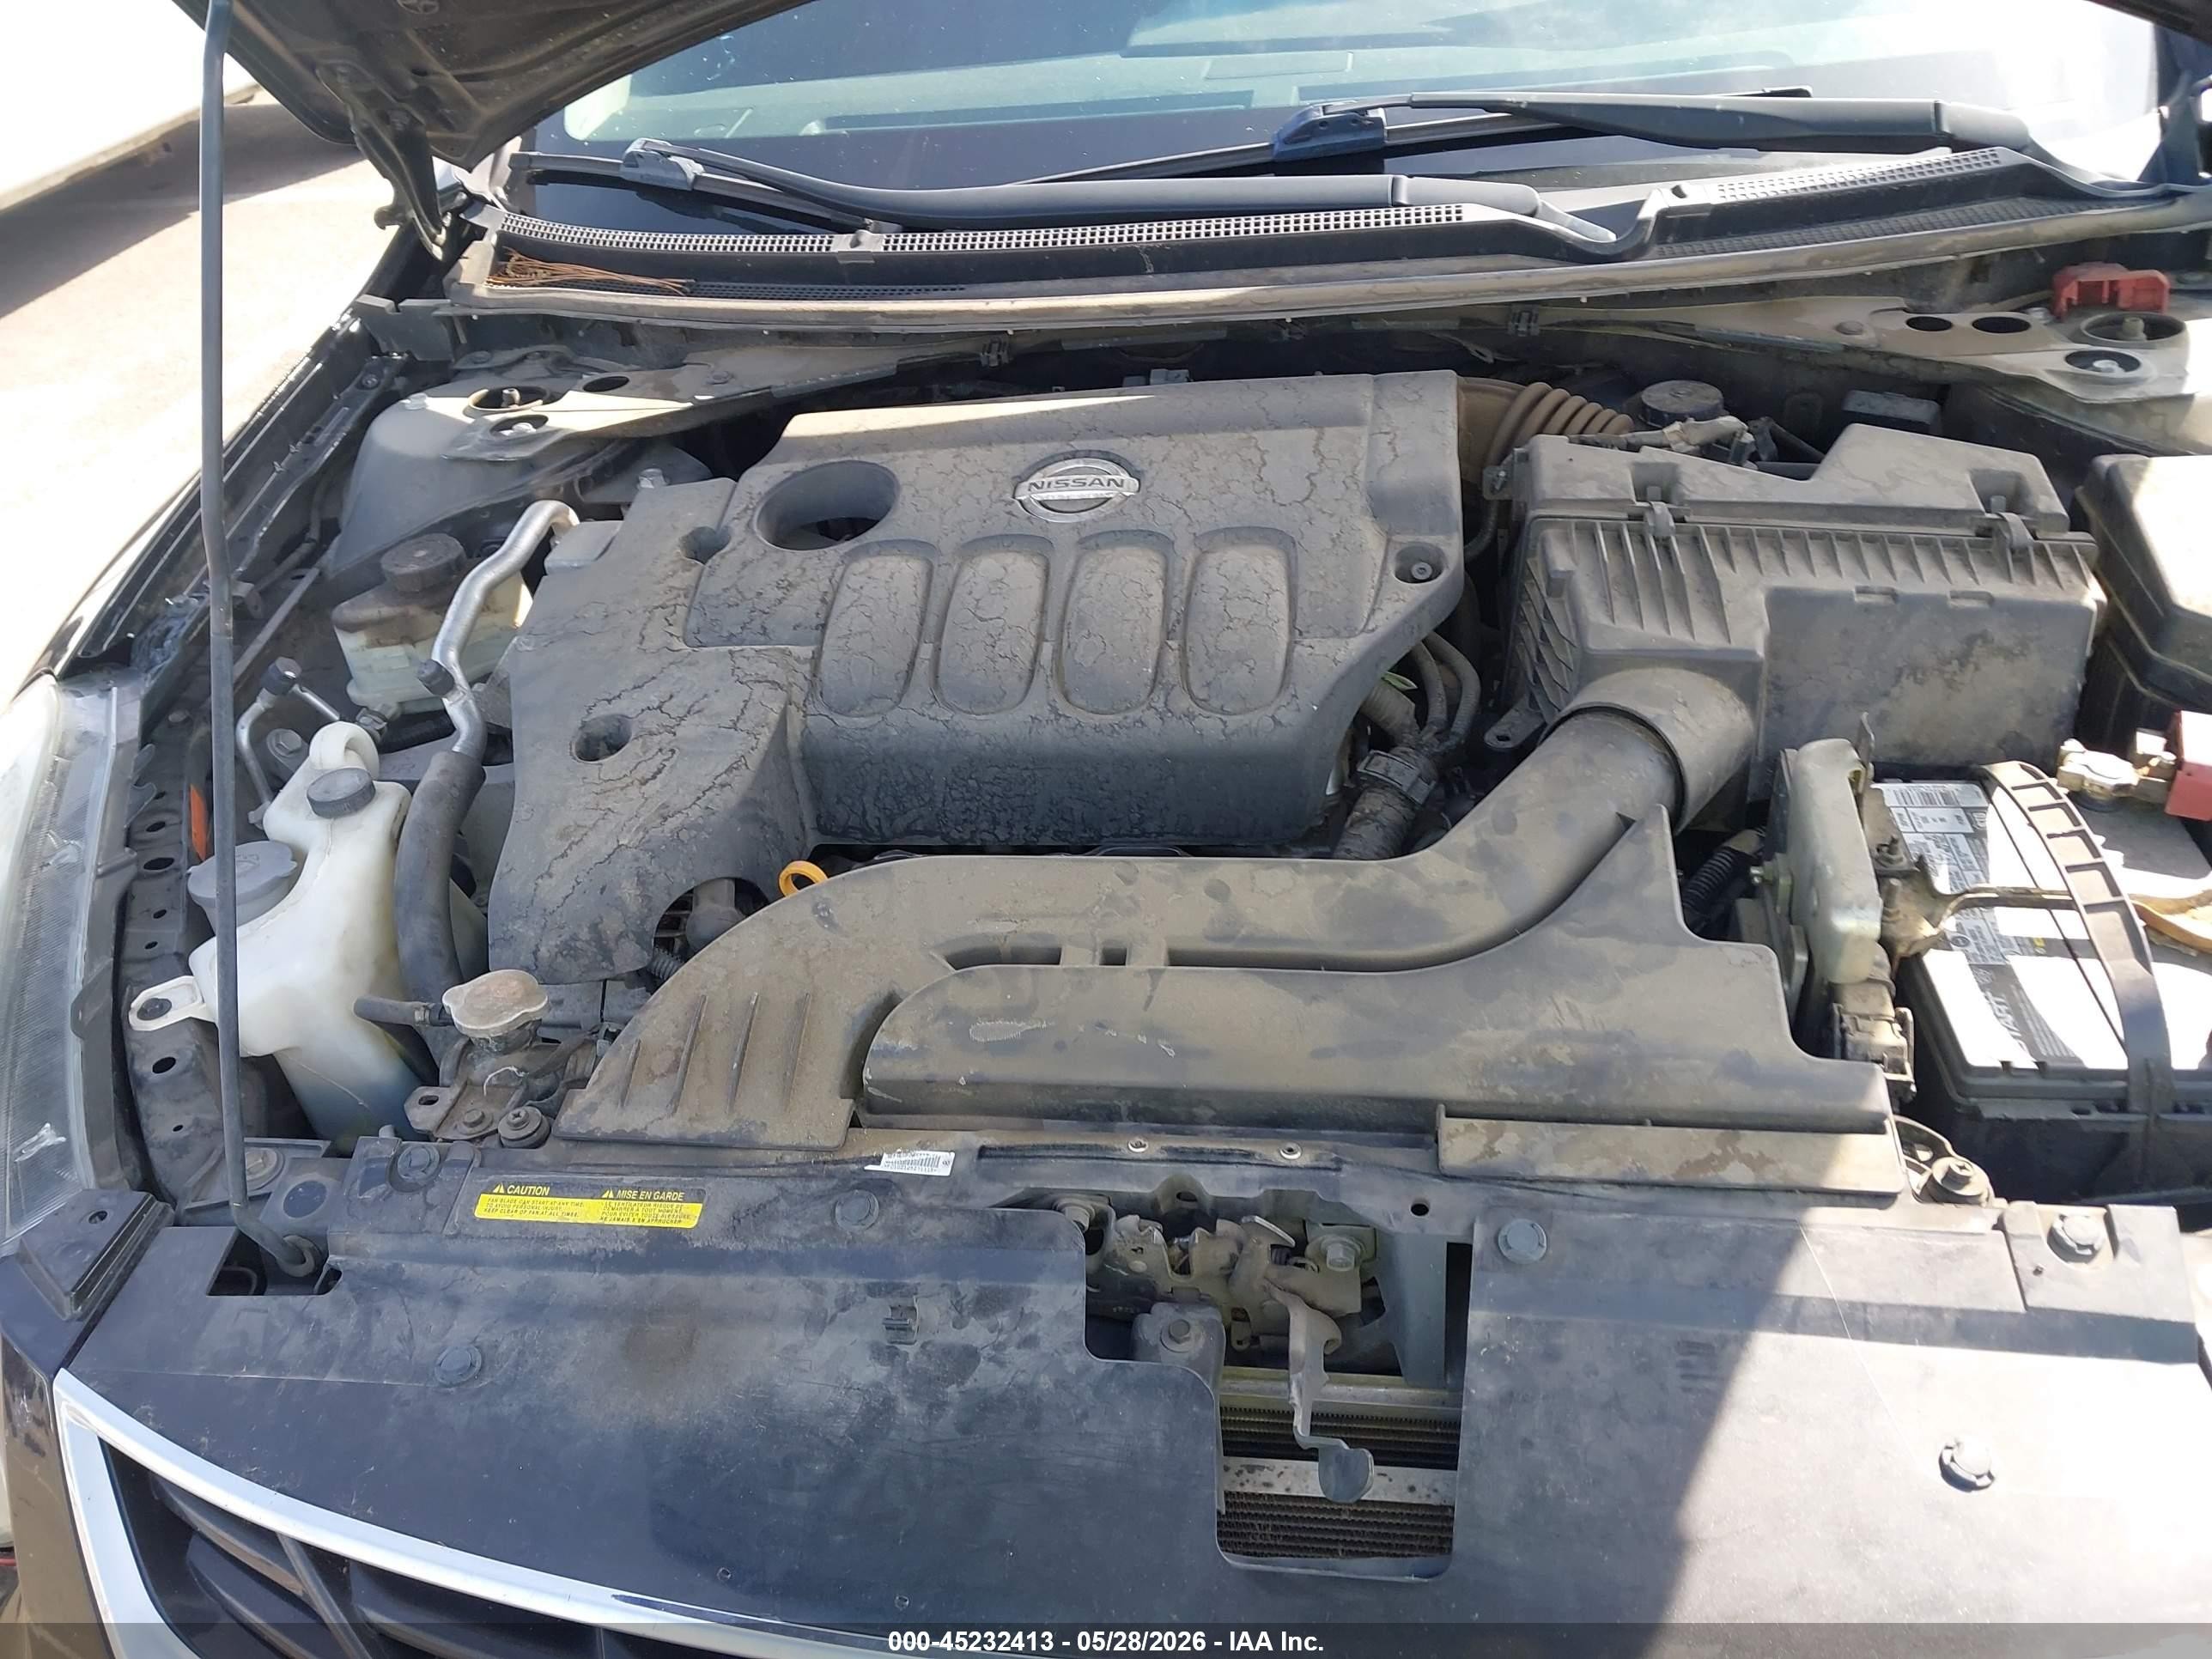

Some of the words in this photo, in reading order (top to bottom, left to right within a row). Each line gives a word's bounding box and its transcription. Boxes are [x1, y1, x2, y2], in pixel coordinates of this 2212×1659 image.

[1028, 477, 1125, 491] NISSAN
[507, 1184, 550, 1196] CAUTION
[617, 1189, 639, 1200] MISE
[639, 1190, 653, 1200] EN
[653, 1190, 685, 1201] GARDE
